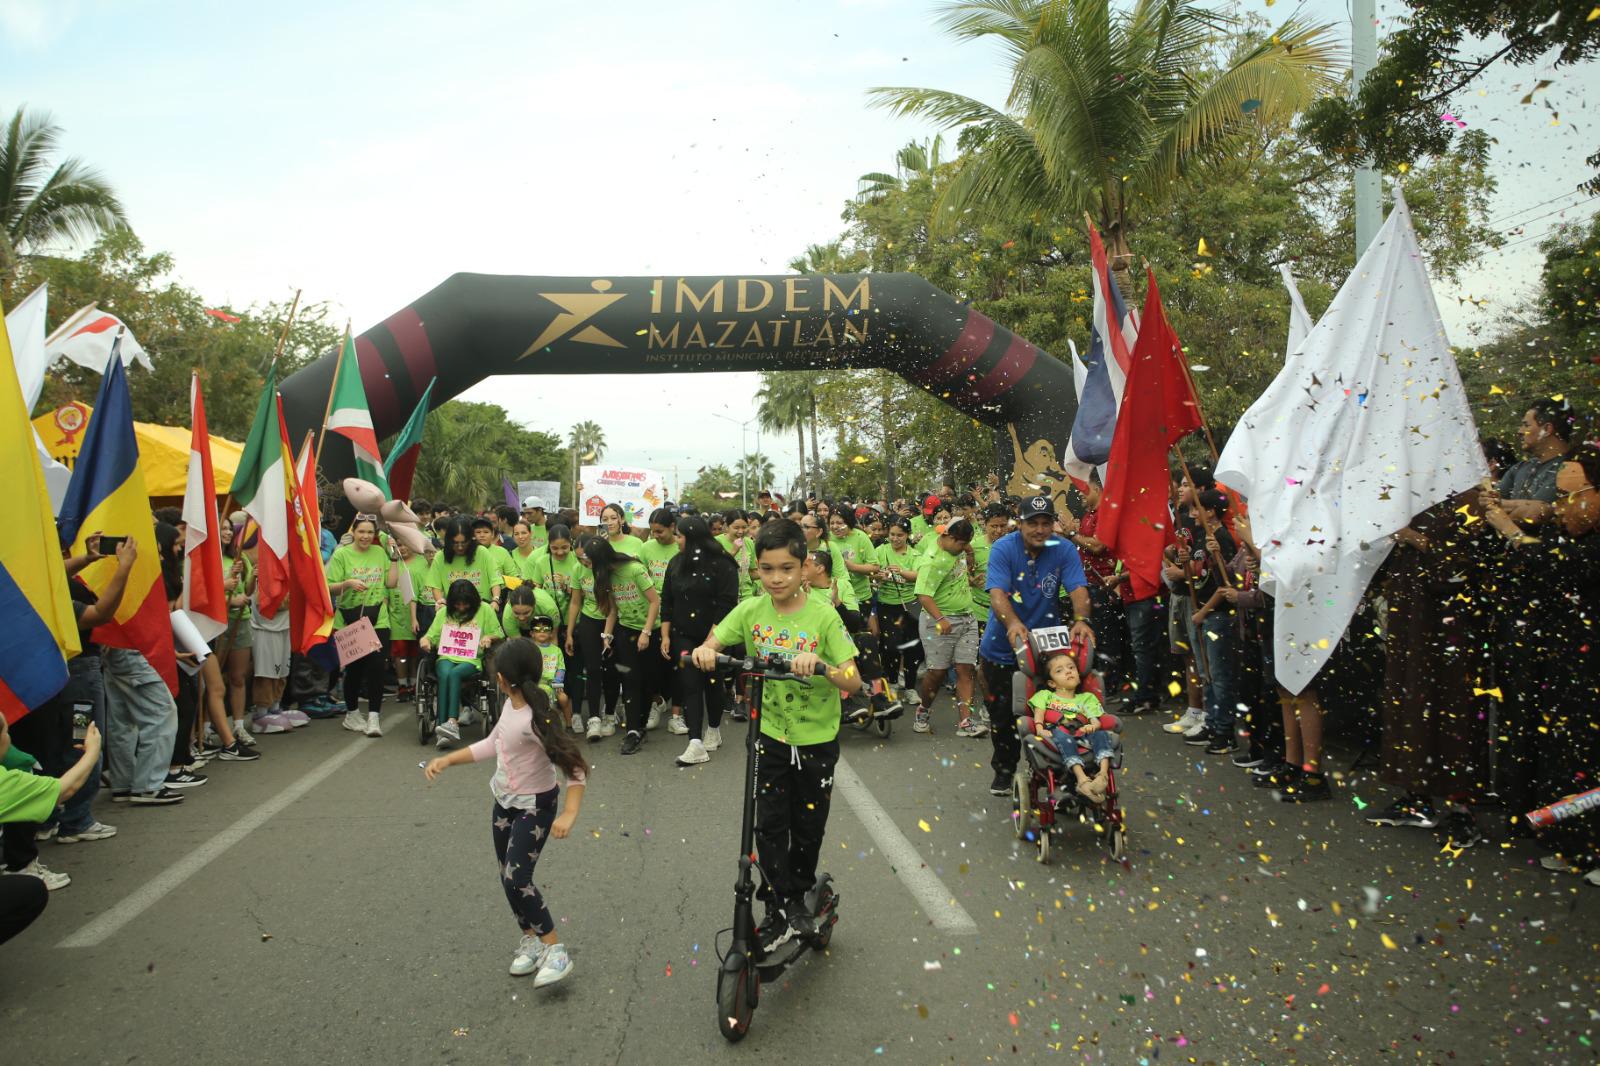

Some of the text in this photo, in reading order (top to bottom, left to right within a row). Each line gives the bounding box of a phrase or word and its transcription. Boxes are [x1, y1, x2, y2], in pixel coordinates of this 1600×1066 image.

[651, 277, 869, 313] IMDEM
[648, 312, 869, 349] MAZATLÁN
[646, 353, 712, 362] INSTITUTO
[715, 352, 779, 361] MUNICIPAL
[449, 630, 473, 640] NADA
[454, 639, 467, 647] ME
[1036, 632, 1069, 650] 050
[442, 646, 475, 657] DETIENE
